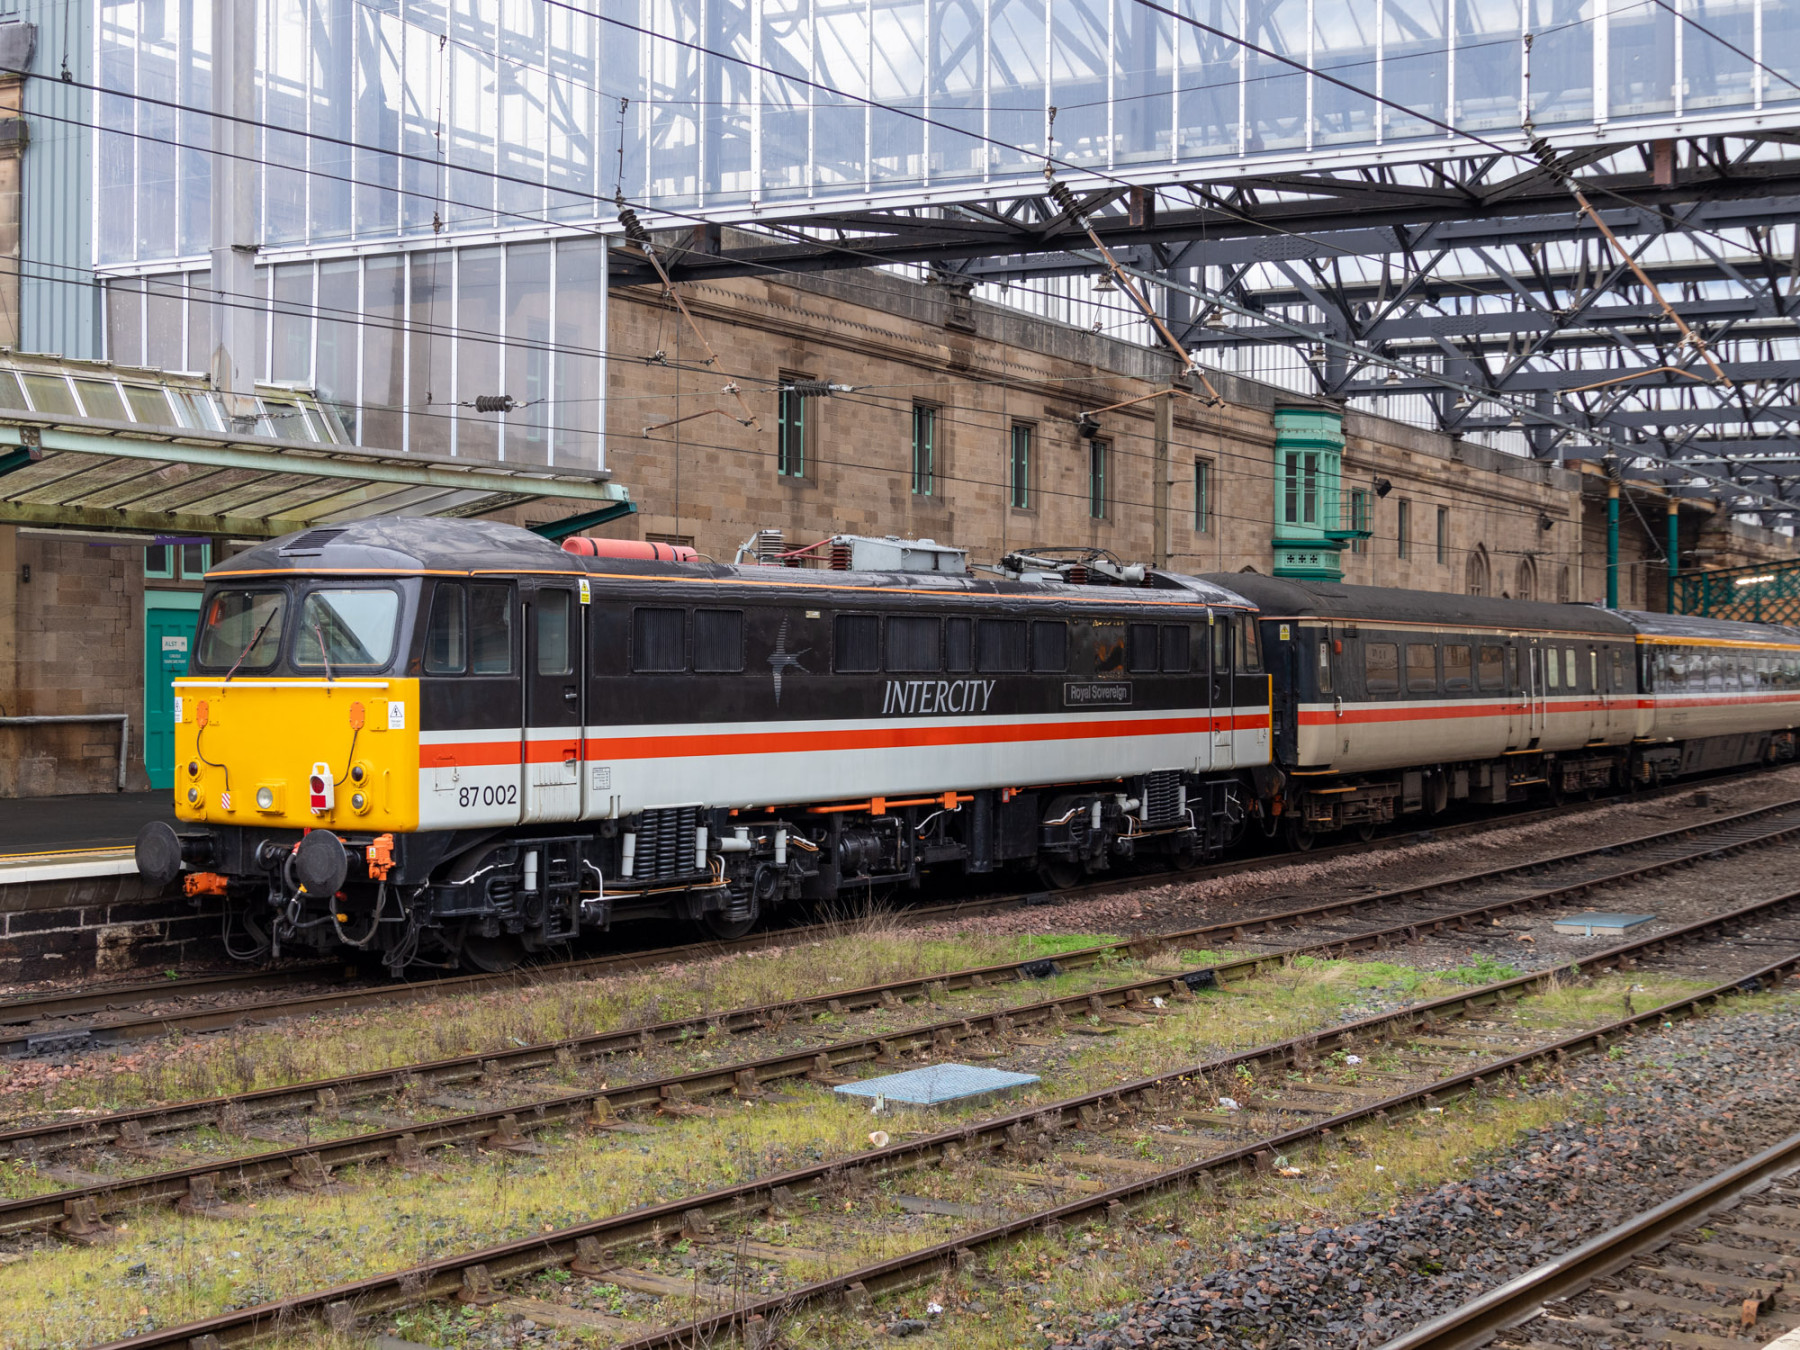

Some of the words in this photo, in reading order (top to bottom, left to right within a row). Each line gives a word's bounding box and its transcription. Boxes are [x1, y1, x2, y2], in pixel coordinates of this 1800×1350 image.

[881, 680, 996, 714] INTERCITY
[1070, 685, 1091, 702] Royal
[1092, 685, 1127, 701] Sovereign
